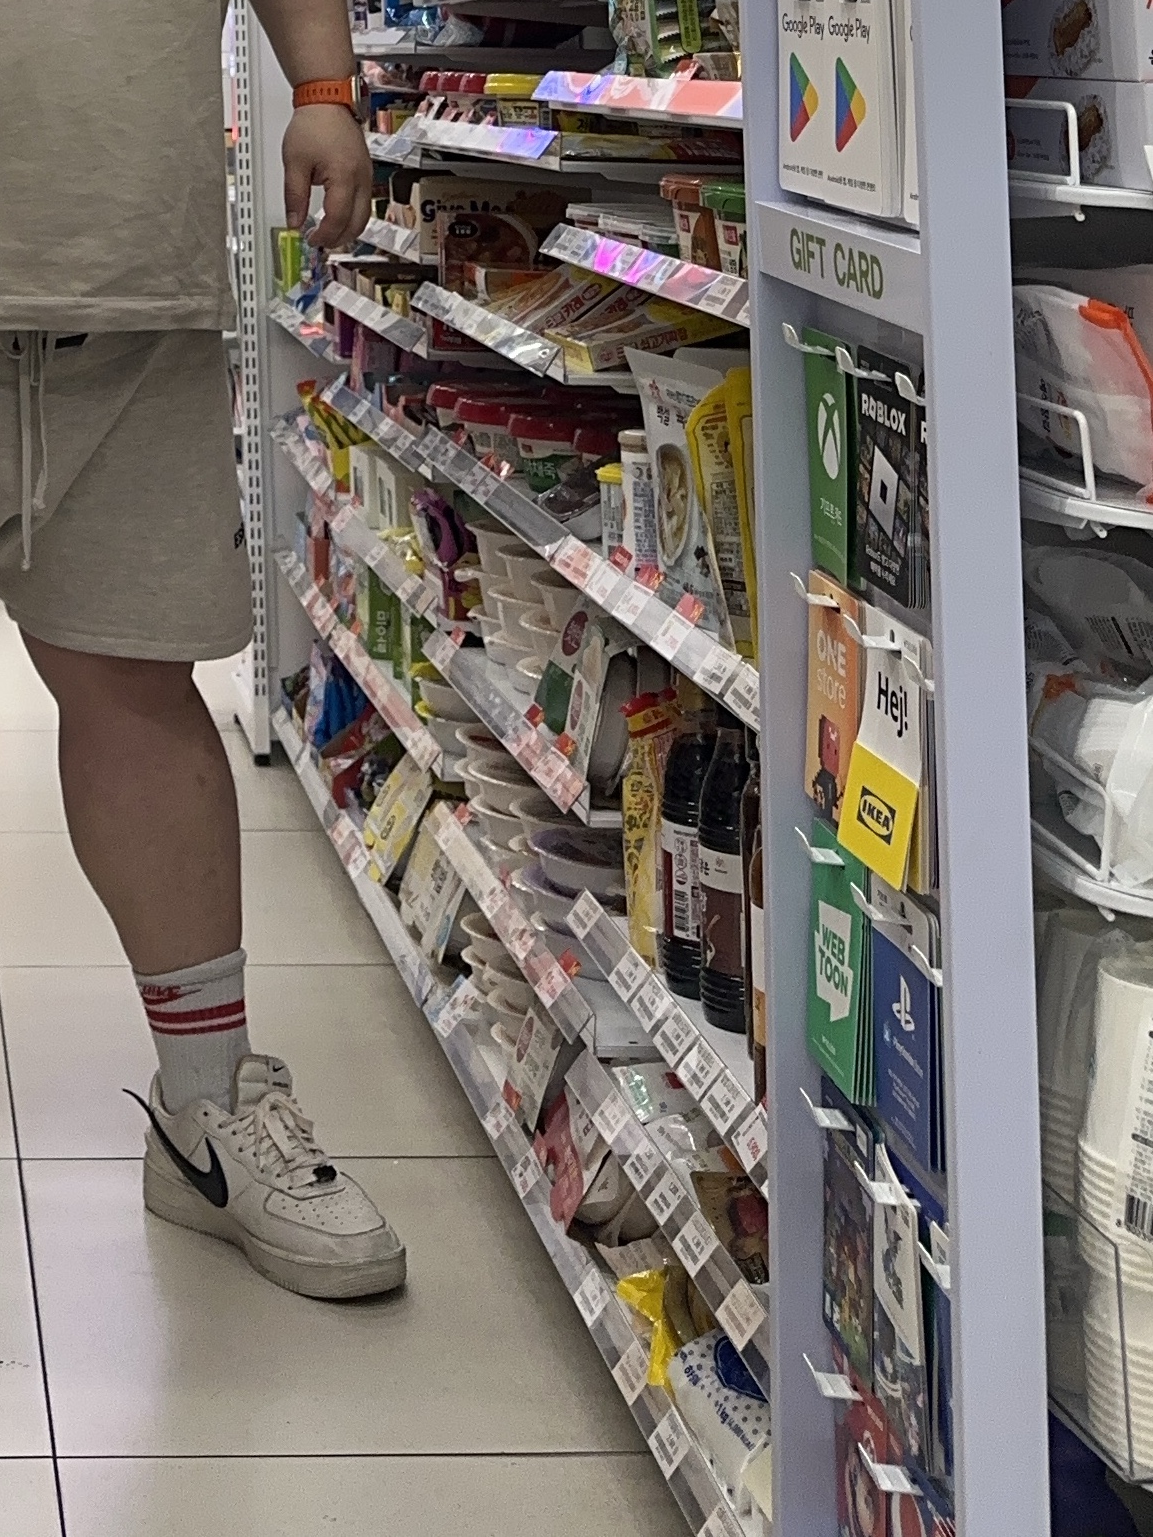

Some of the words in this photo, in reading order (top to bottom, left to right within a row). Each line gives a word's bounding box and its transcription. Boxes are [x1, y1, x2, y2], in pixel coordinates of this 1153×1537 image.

[782, 13, 808, 39] Google
[809, 14, 825, 41] Play
[828, 15, 855, 42] Google
[855, 16, 871, 44] Play
[789, 228, 826, 280] GIFT
[833, 242, 885, 301] CARD
[860, 392, 907, 437] ROBLOX
[816, 629, 847, 678] ONE
[816, 667, 847, 710] store
[877, 671, 909, 738] Hej!
[861, 799, 892, 832] IKEA
[822, 923, 846, 966] WEB
[818, 946, 849, 998] TOON
